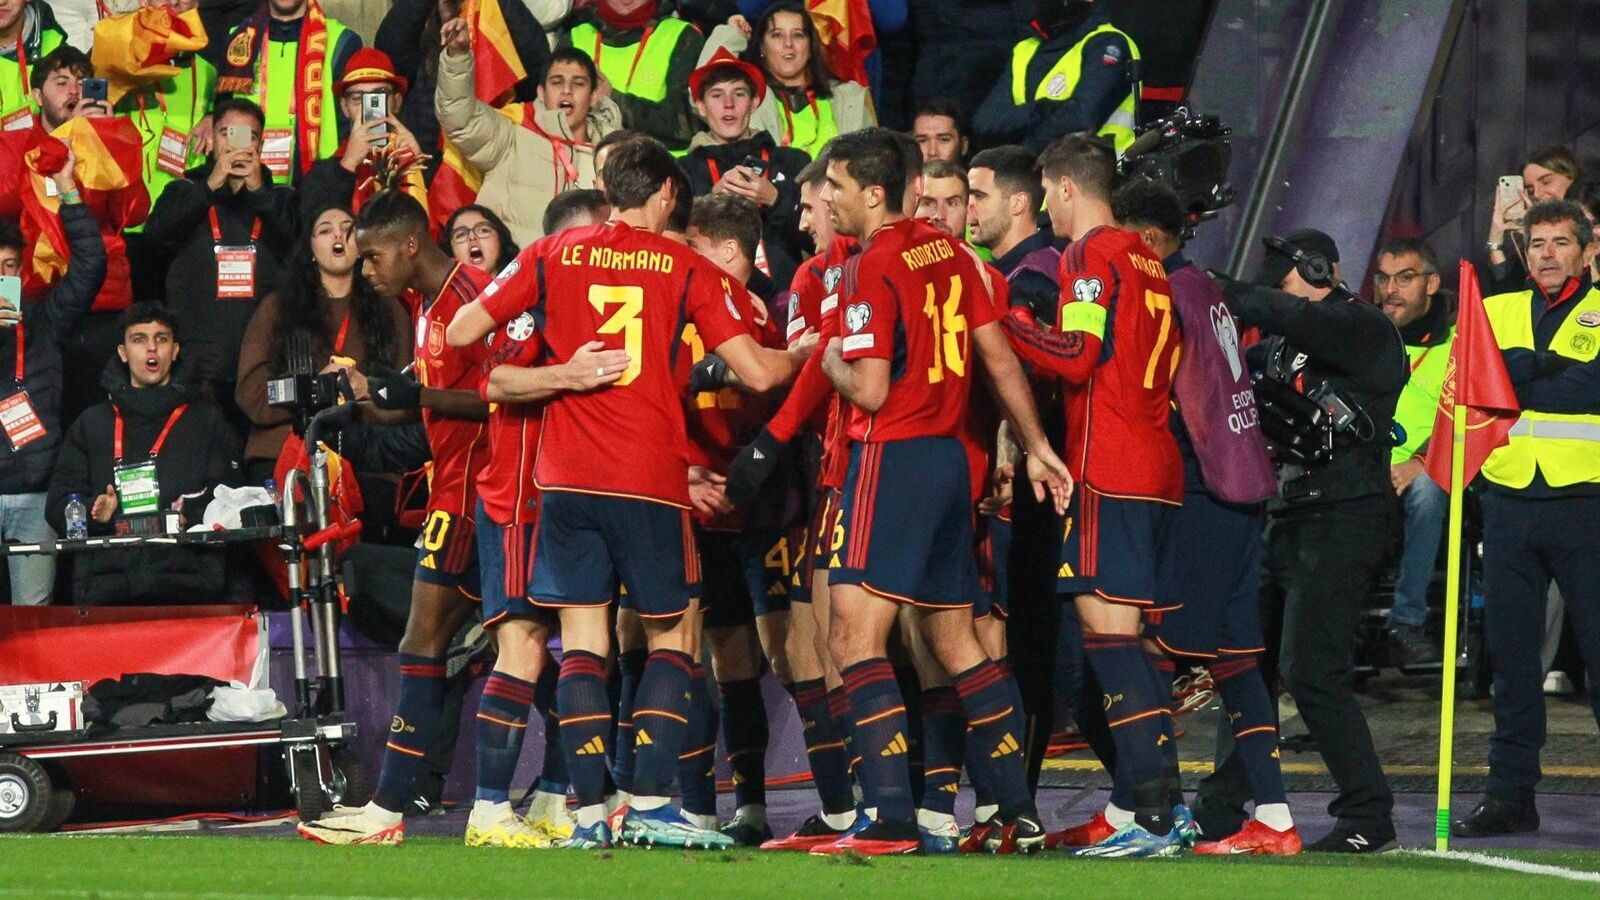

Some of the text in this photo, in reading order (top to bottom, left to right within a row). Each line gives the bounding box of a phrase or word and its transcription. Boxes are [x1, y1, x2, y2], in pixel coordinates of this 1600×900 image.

[561, 245, 673, 274] LE NORMAND
[901, 238, 955, 271] RODRIGO
[588, 284, 644, 386] 3
[923, 274, 968, 385] 16
[1143, 289, 1172, 389] 7
[765, 536, 790, 576] 4
